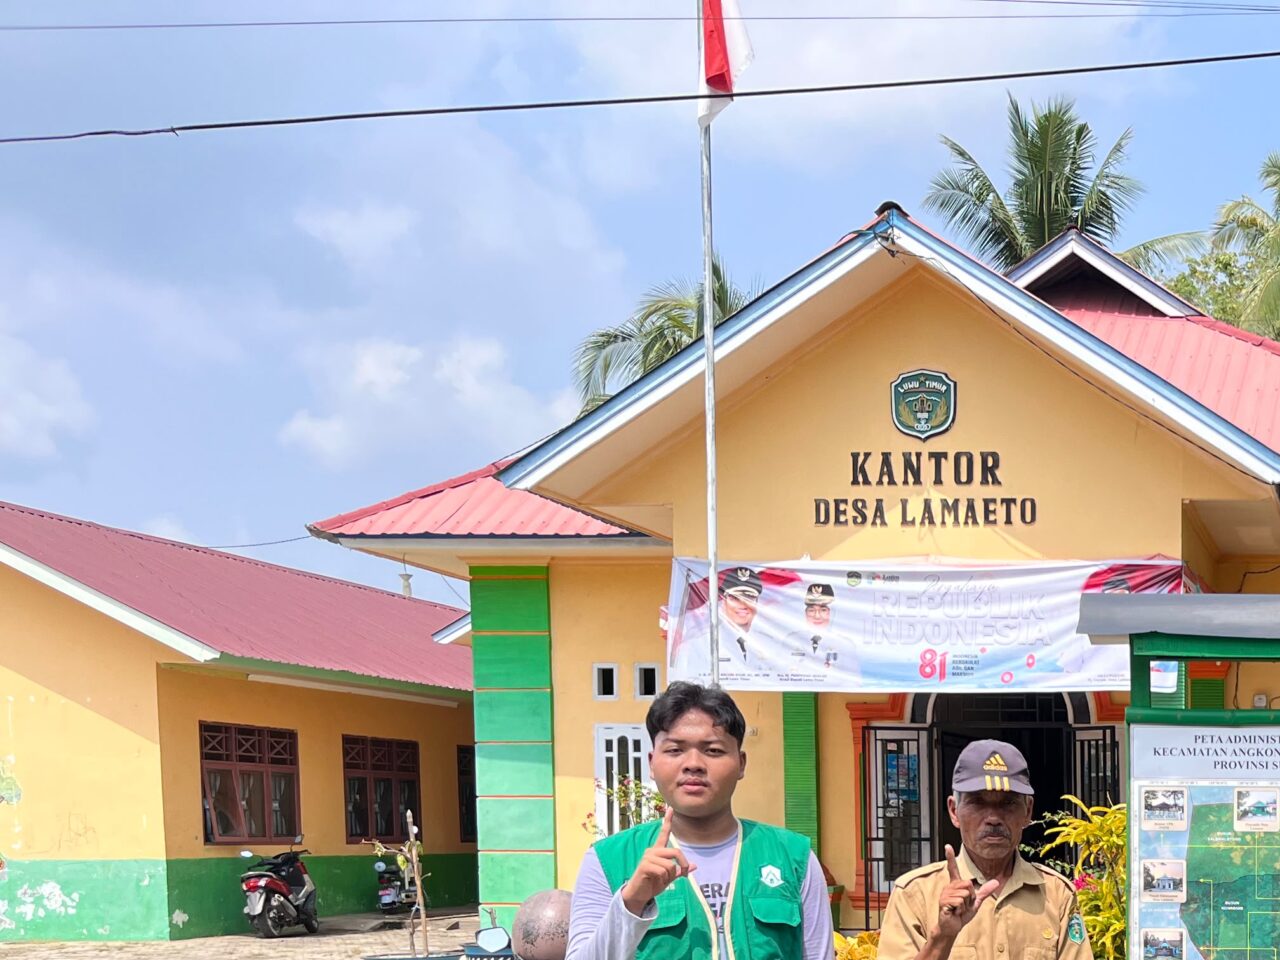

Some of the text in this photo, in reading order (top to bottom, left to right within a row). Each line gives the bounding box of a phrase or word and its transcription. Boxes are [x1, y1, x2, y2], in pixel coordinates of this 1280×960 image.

[925, 380, 947, 393] TIMUR
[850, 451, 1002, 486] KANTOR
[814, 498, 1037, 527] DESA LAMAETO
[918, 648, 949, 683] 81
[1194, 734, 1224, 744] PETA
[1153, 746, 1228, 757] KECAMATAN
[1213, 760, 1270, 770] PROVINSI
